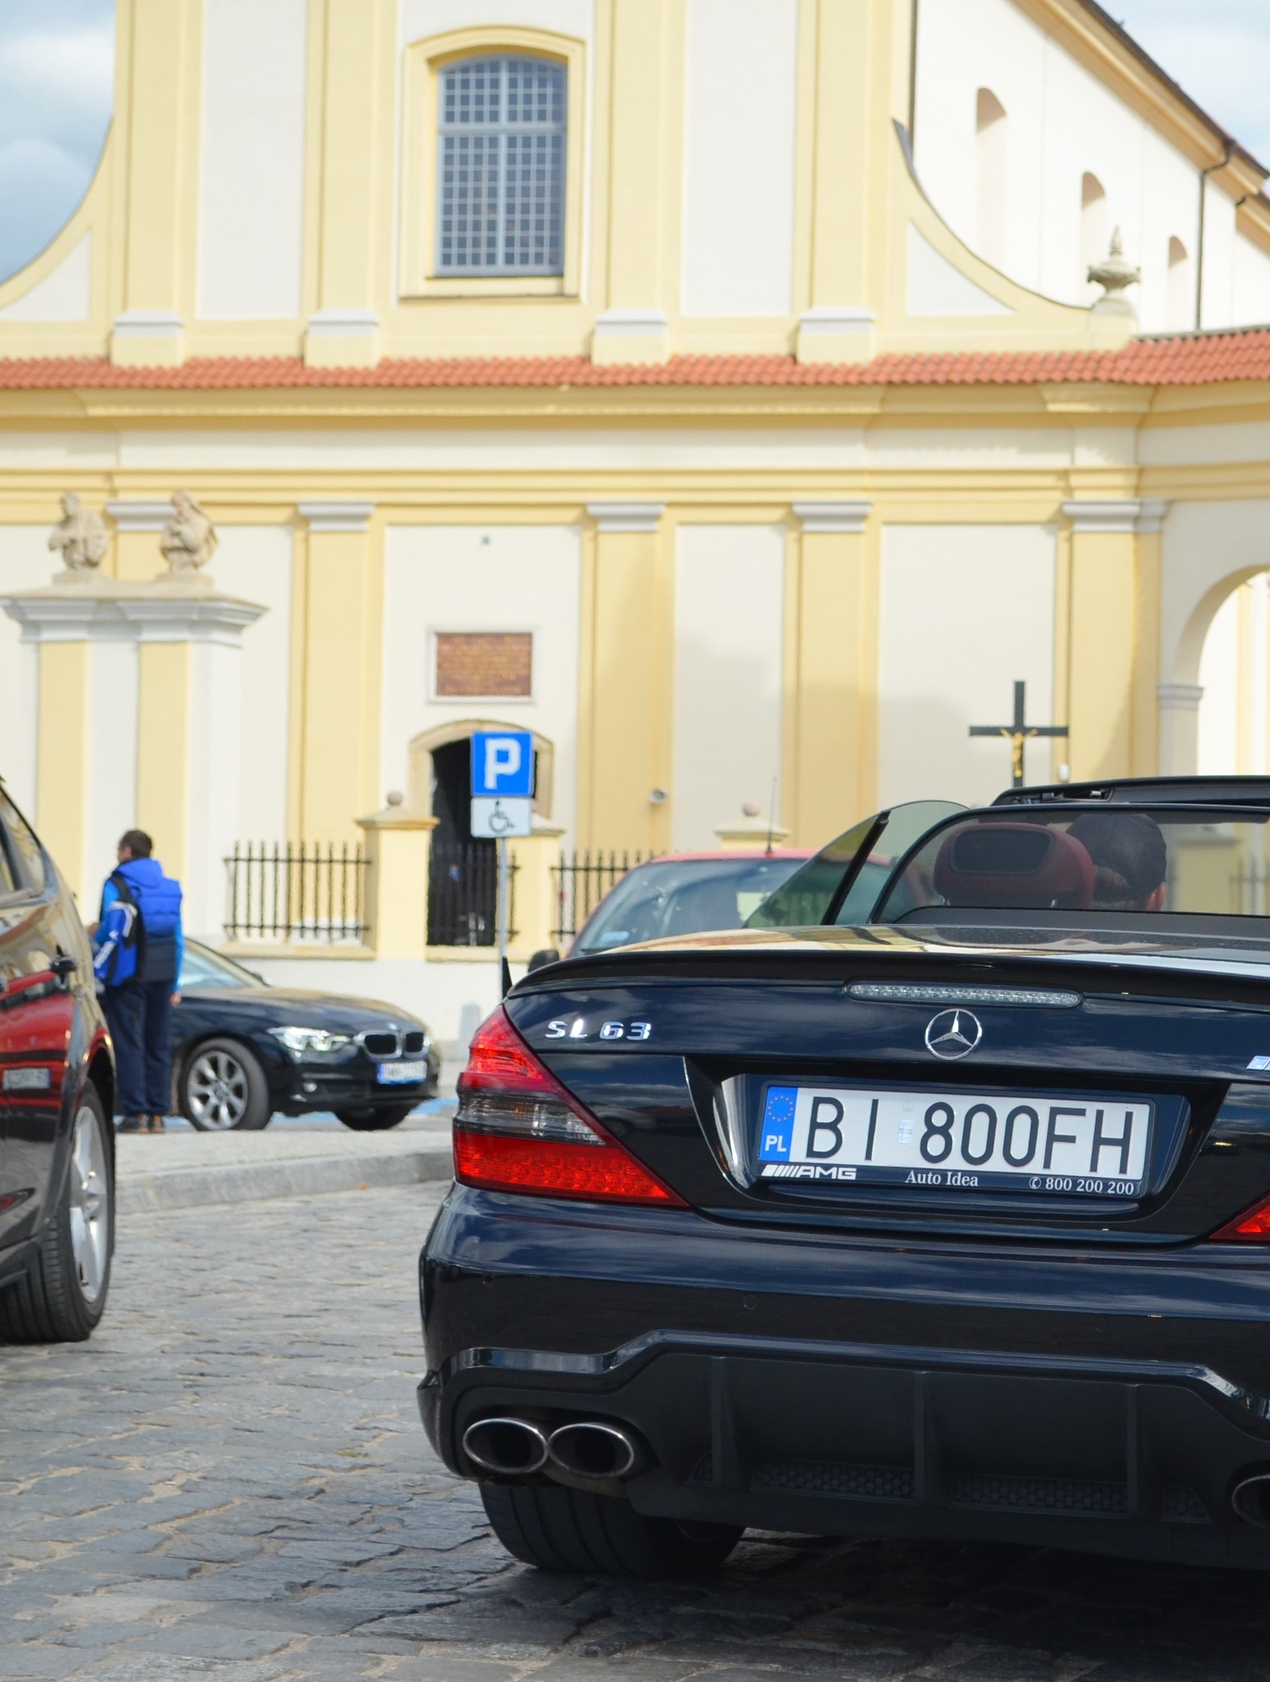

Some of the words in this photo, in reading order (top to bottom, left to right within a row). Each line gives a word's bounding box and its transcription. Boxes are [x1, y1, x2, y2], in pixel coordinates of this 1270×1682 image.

[484, 738, 522, 790] P
[545, 1019, 588, 1039] SL
[599, 1021, 652, 1041] 63
[764, 1134, 787, 1152] PL
[805, 1096, 880, 1162] BI
[919, 1101, 1134, 1175] 800FH
[797, 1165, 857, 1180] AMG
[904, 1169, 942, 1185] Auto
[945, 1171, 979, 1187] Idea
[1045, 1178, 1073, 1192] 800
[1076, 1179, 1104, 1193] 200
[1107, 1180, 1135, 1196] 200
